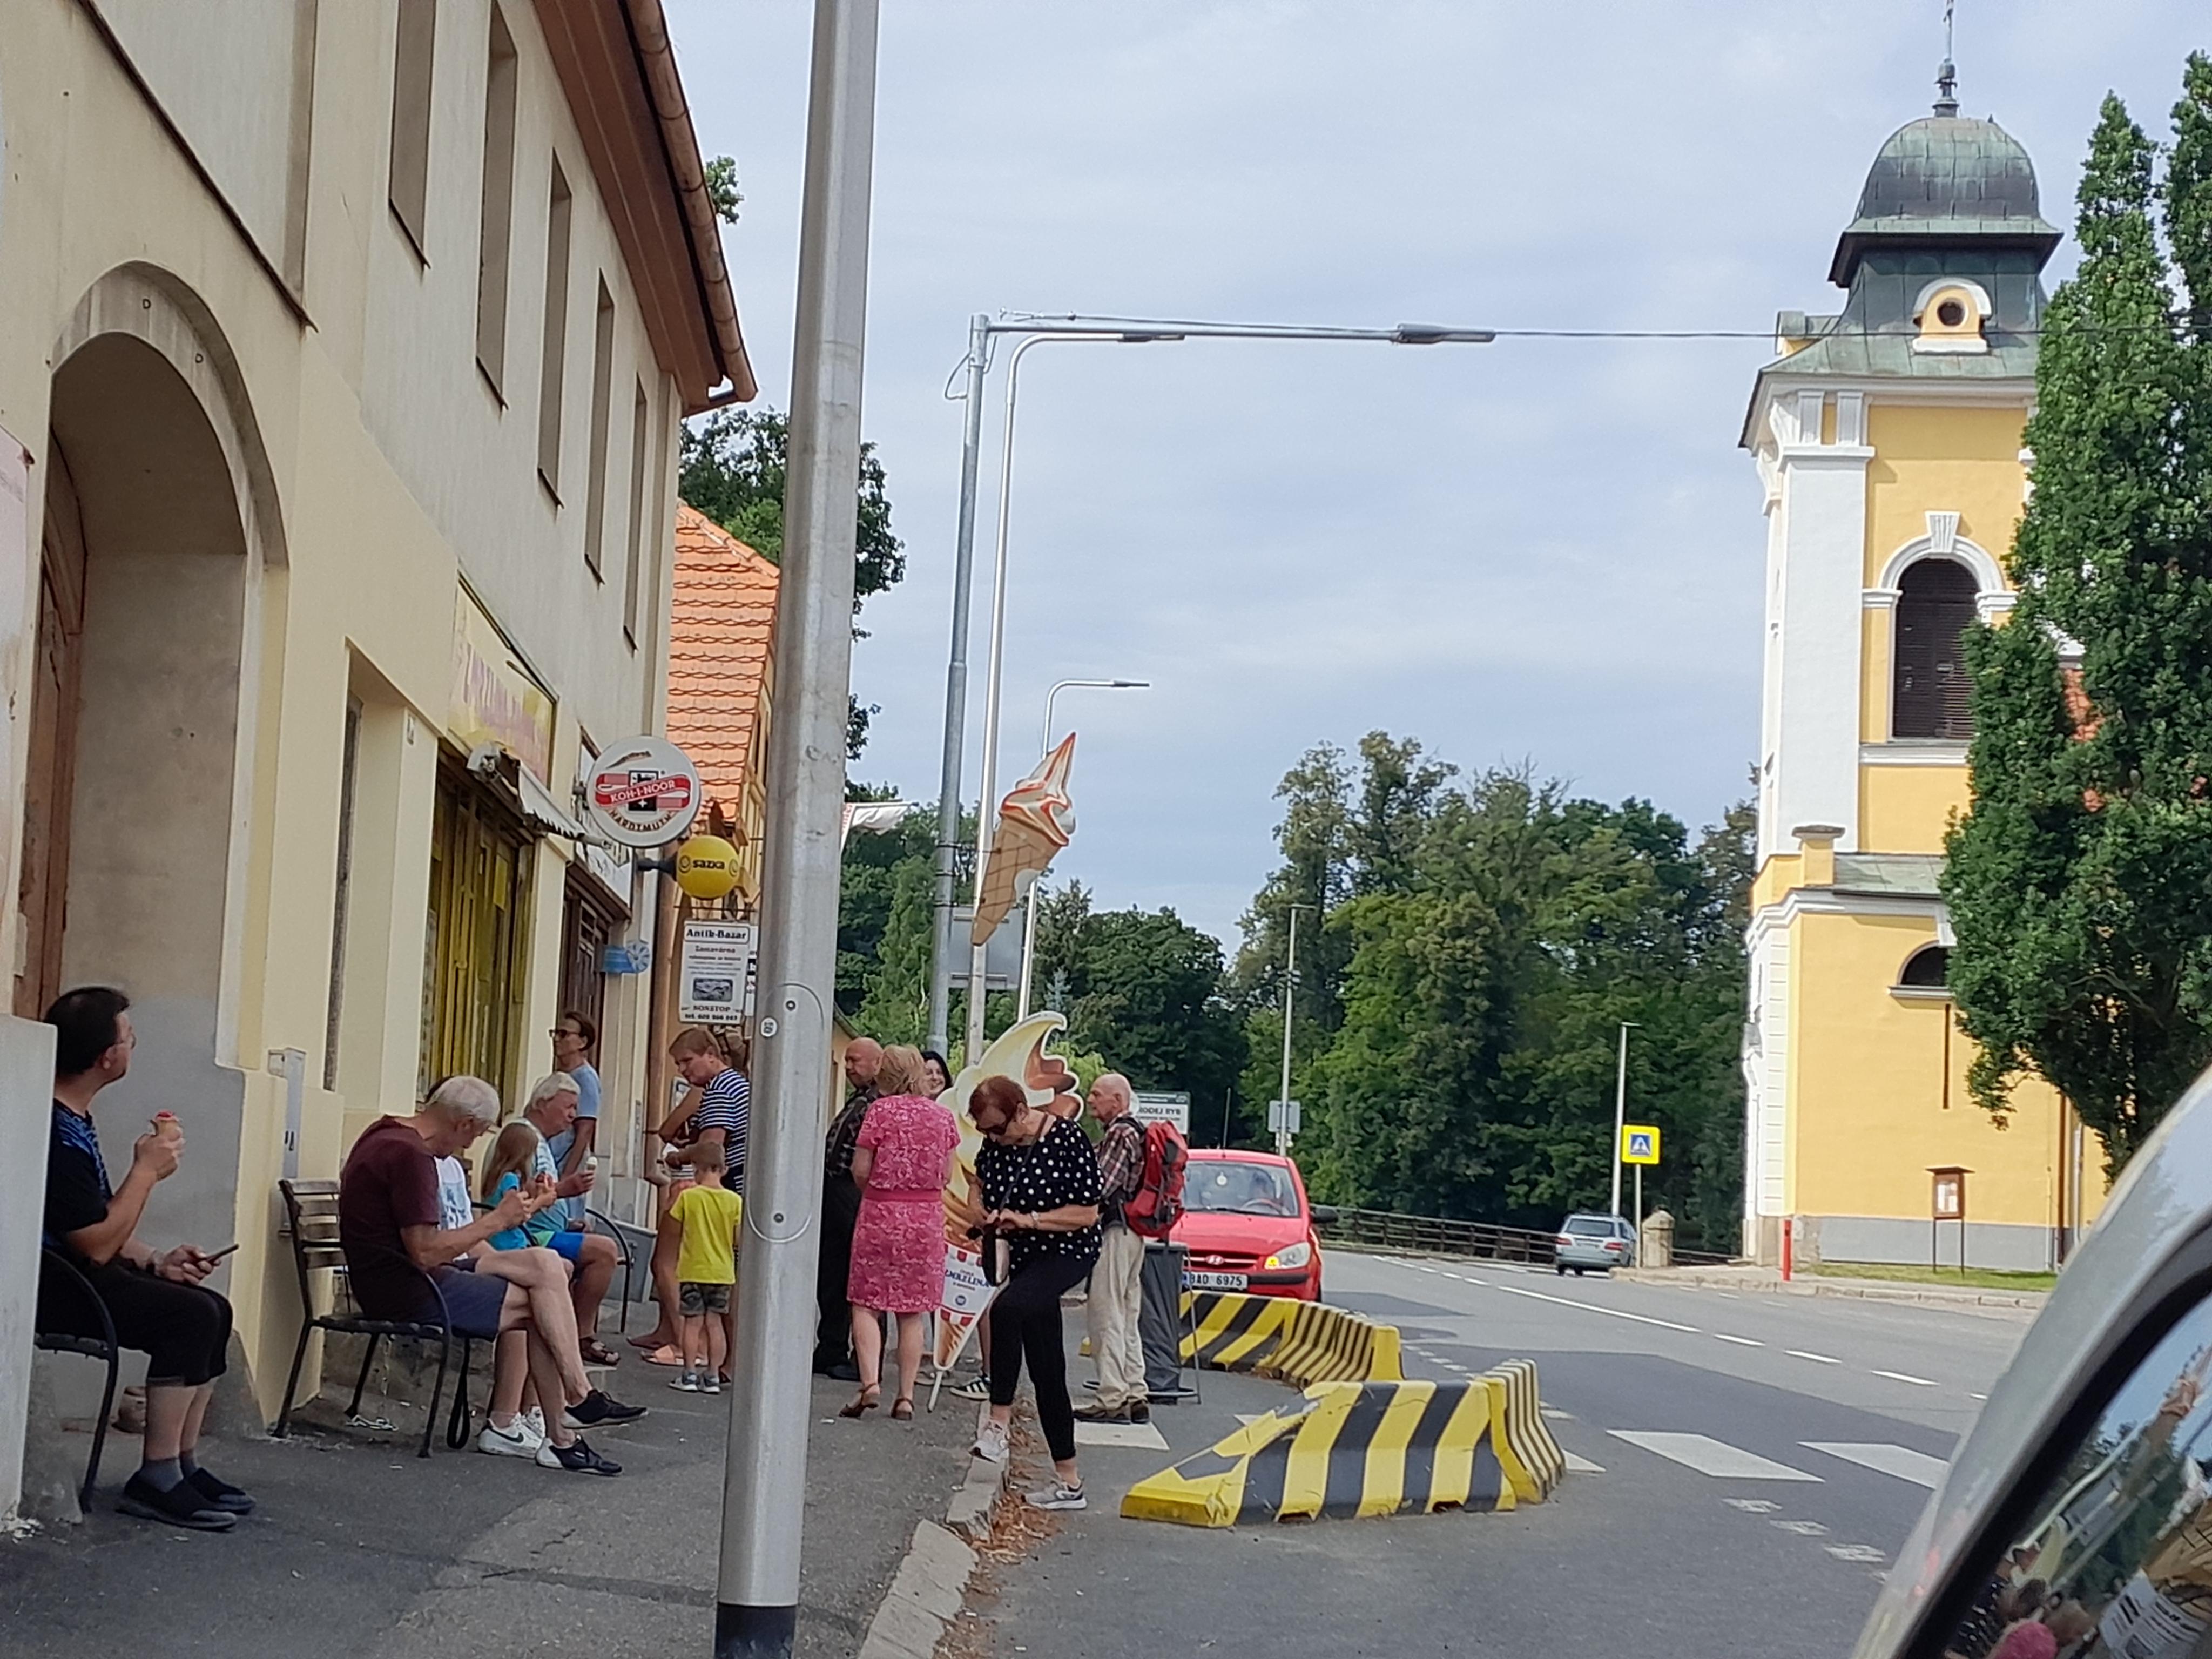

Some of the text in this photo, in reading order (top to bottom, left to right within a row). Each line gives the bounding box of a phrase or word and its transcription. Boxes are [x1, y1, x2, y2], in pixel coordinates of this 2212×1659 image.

[610, 780, 676, 802] KOH-I-NOOR
[686, 928, 746, 939] Antik-Bazar
[1216, 1274, 1243, 1286] 6975
